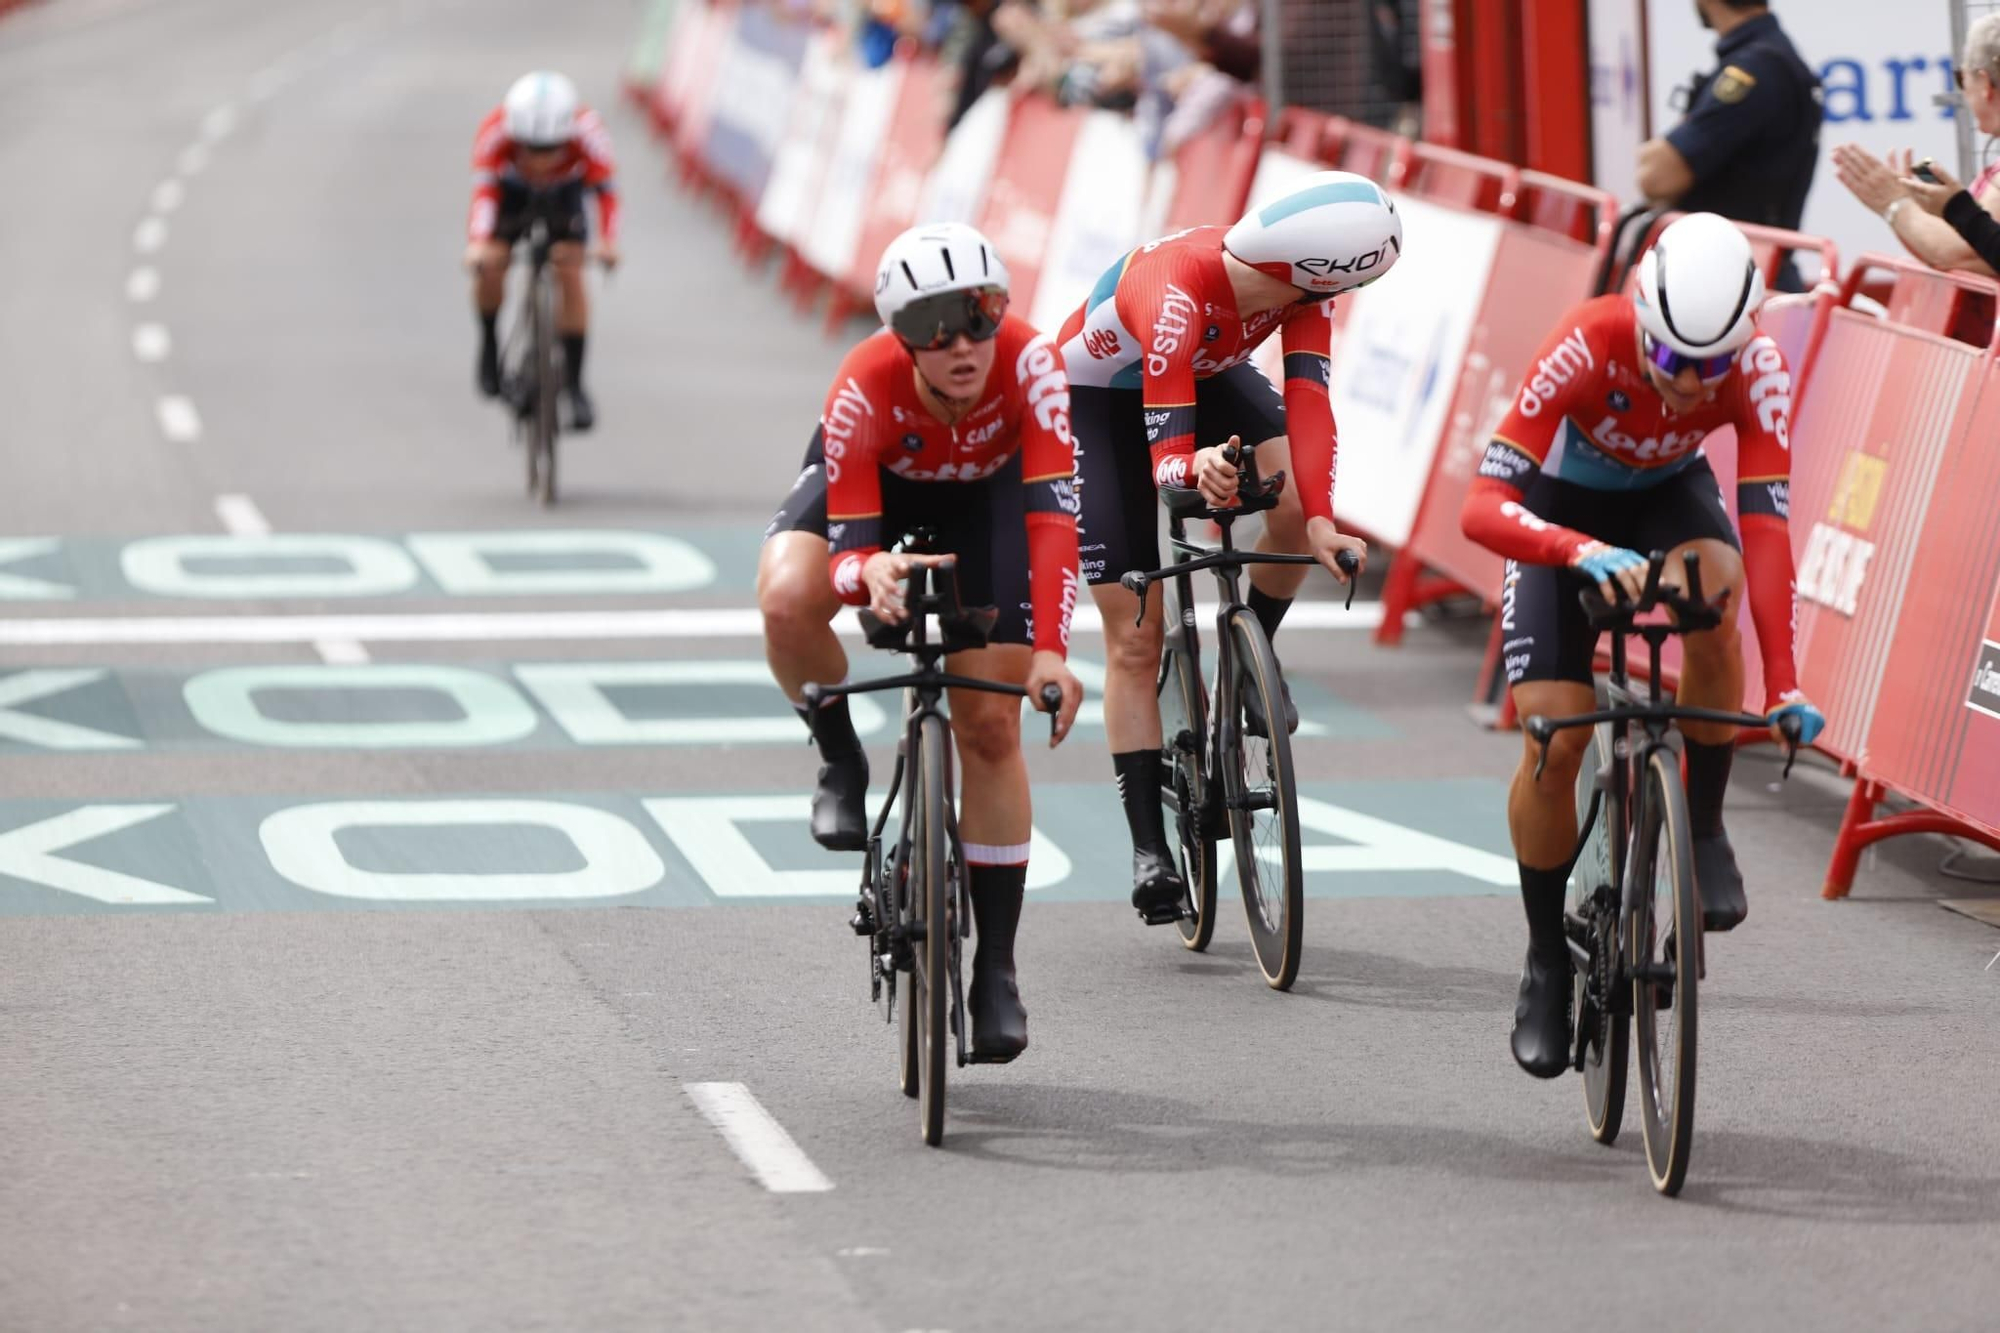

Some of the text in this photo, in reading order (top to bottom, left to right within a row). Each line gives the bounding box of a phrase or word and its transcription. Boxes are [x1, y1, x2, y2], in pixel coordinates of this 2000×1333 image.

[1146, 283, 1198, 377] dstny
[1519, 325, 1595, 417] dstny
[823, 376, 874, 483] dstny
